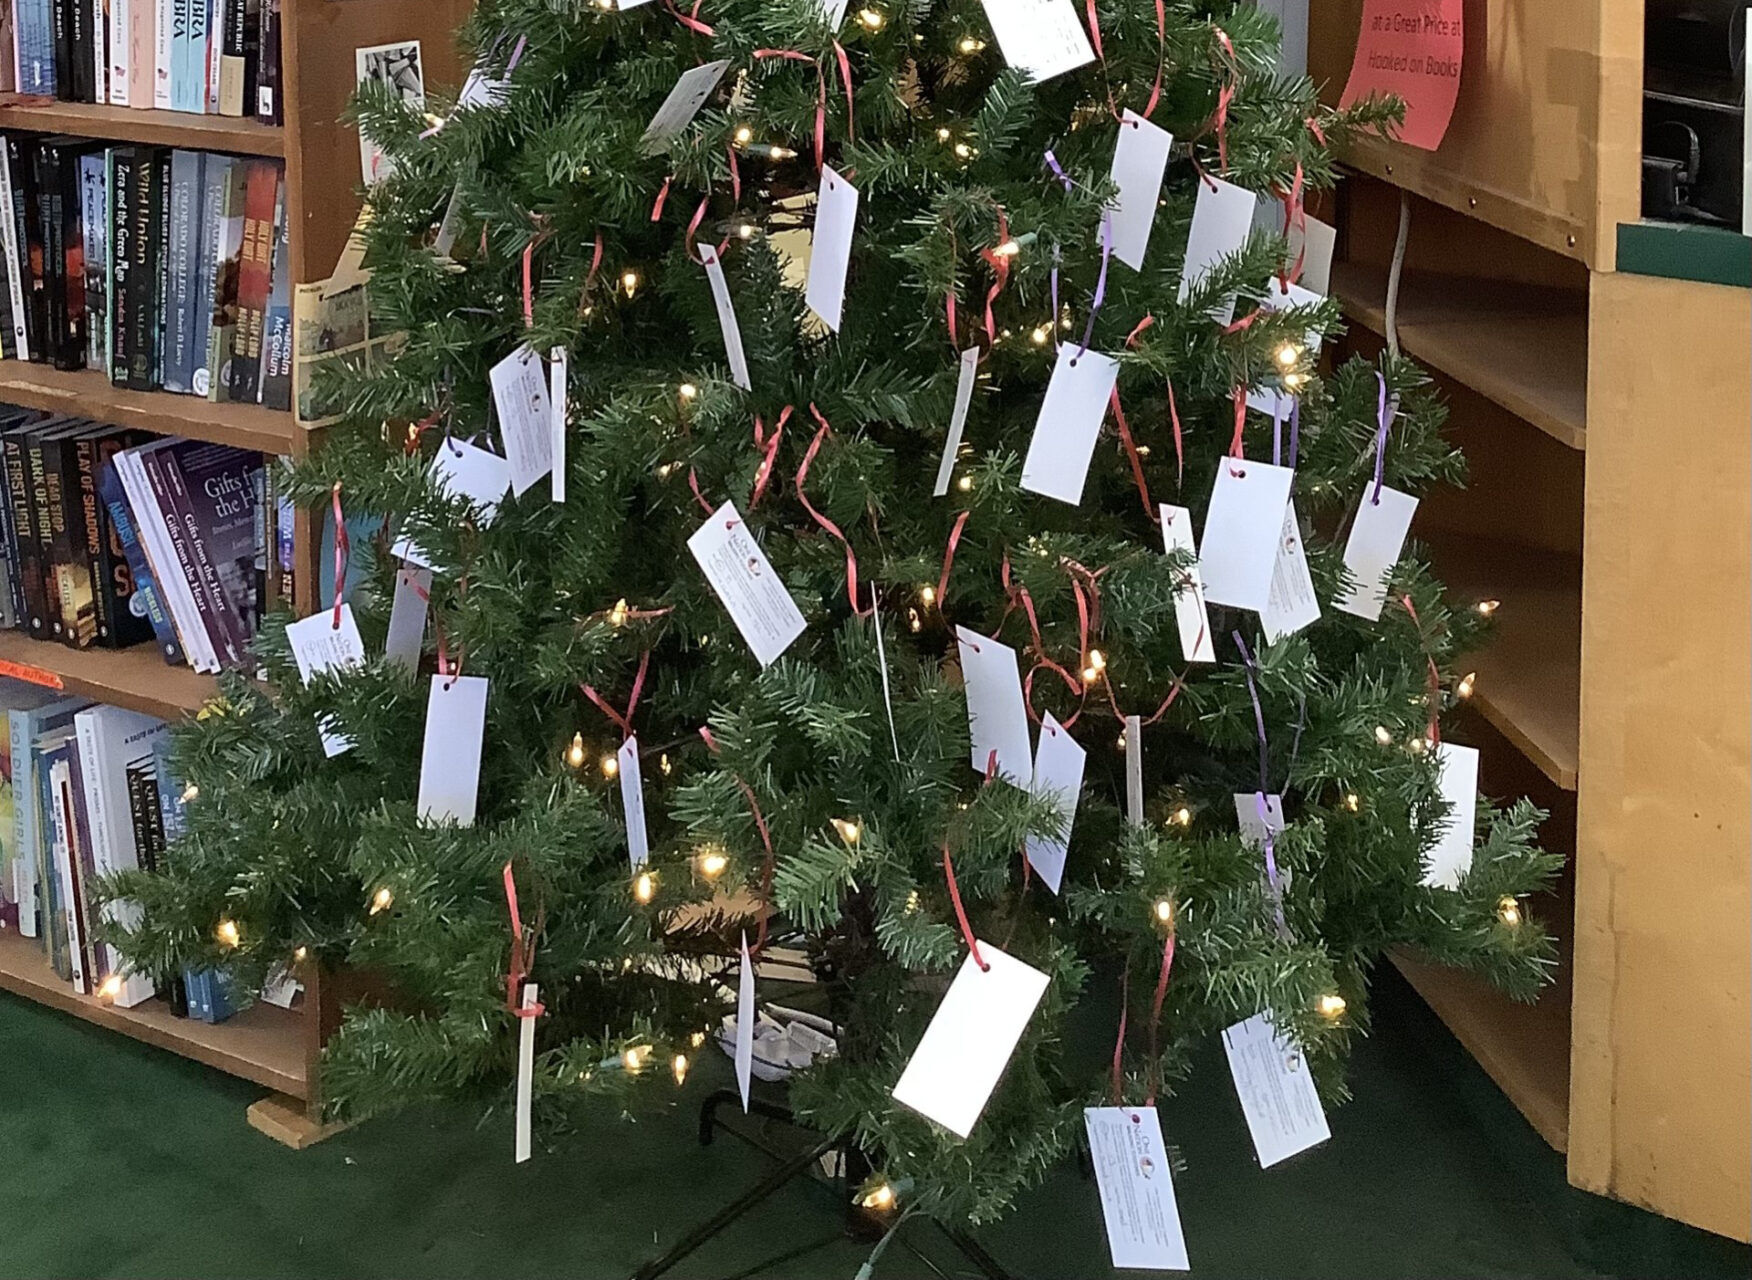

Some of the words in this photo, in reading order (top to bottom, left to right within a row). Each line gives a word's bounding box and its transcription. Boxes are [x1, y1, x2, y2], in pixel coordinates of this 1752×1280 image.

[235, 11, 244, 54] REPUBLIC
[1372, 15, 1383, 31] at
[1384, 16, 1391, 31] a
[1393, 12, 1422, 33] Great
[1424, 15, 1448, 35] Price
[1450, 19, 1461, 36] at
[1368, 49, 1407, 72] Hooked
[1408, 58, 1423, 73] on
[1425, 54, 1458, 78] Books
[117, 189, 129, 208] and
[137, 162, 150, 204] Wild
[86, 187, 96, 259] PEACEMAKER
[116, 210, 129, 226] the
[176, 181, 188, 248] COLORADO
[243, 218, 256, 240] HOLY
[257, 220, 270, 242] HOLY
[117, 228, 129, 258] Green
[136, 208, 150, 264] Union
[242, 240, 254, 262] DIRT
[255, 243, 268, 264] DIRT
[117, 287, 126, 324] Sandra
[115, 326, 126, 360] Knauf
[269, 316, 284, 377] McCollum
[5, 441, 21, 457] AT
[29, 448, 44, 485] DARK
[76, 442, 91, 474] PLAY
[8, 459, 26, 498] FIRST
[35, 487, 47, 504] OF
[46, 472, 60, 501] DEAD
[81, 475, 94, 492] OF
[204, 471, 242, 499] Gifts
[15, 500, 31, 538] LIGHT
[50, 503, 65, 533] STOP
[83, 493, 100, 554] SHADOWS
[216, 494, 241, 518] the
[38, 505, 53, 544] NIGHT
[108, 501, 135, 548] AMBUSH
[165, 513, 180, 539] Gifts
[174, 539, 188, 564] from
[184, 563, 196, 582] the
[190, 582, 207, 613] Heart
[183, 513, 200, 539] Gifts
[192, 539, 208, 564] from
[202, 564, 216, 582] the
[209, 582, 227, 613] Heart
[10, 720, 23, 801] SOLDIER
[130, 774, 142, 818] QUEST
[144, 785, 158, 829] QUEST
[161, 793, 171, 810] ON
[15, 806, 26, 862] GIRLS
